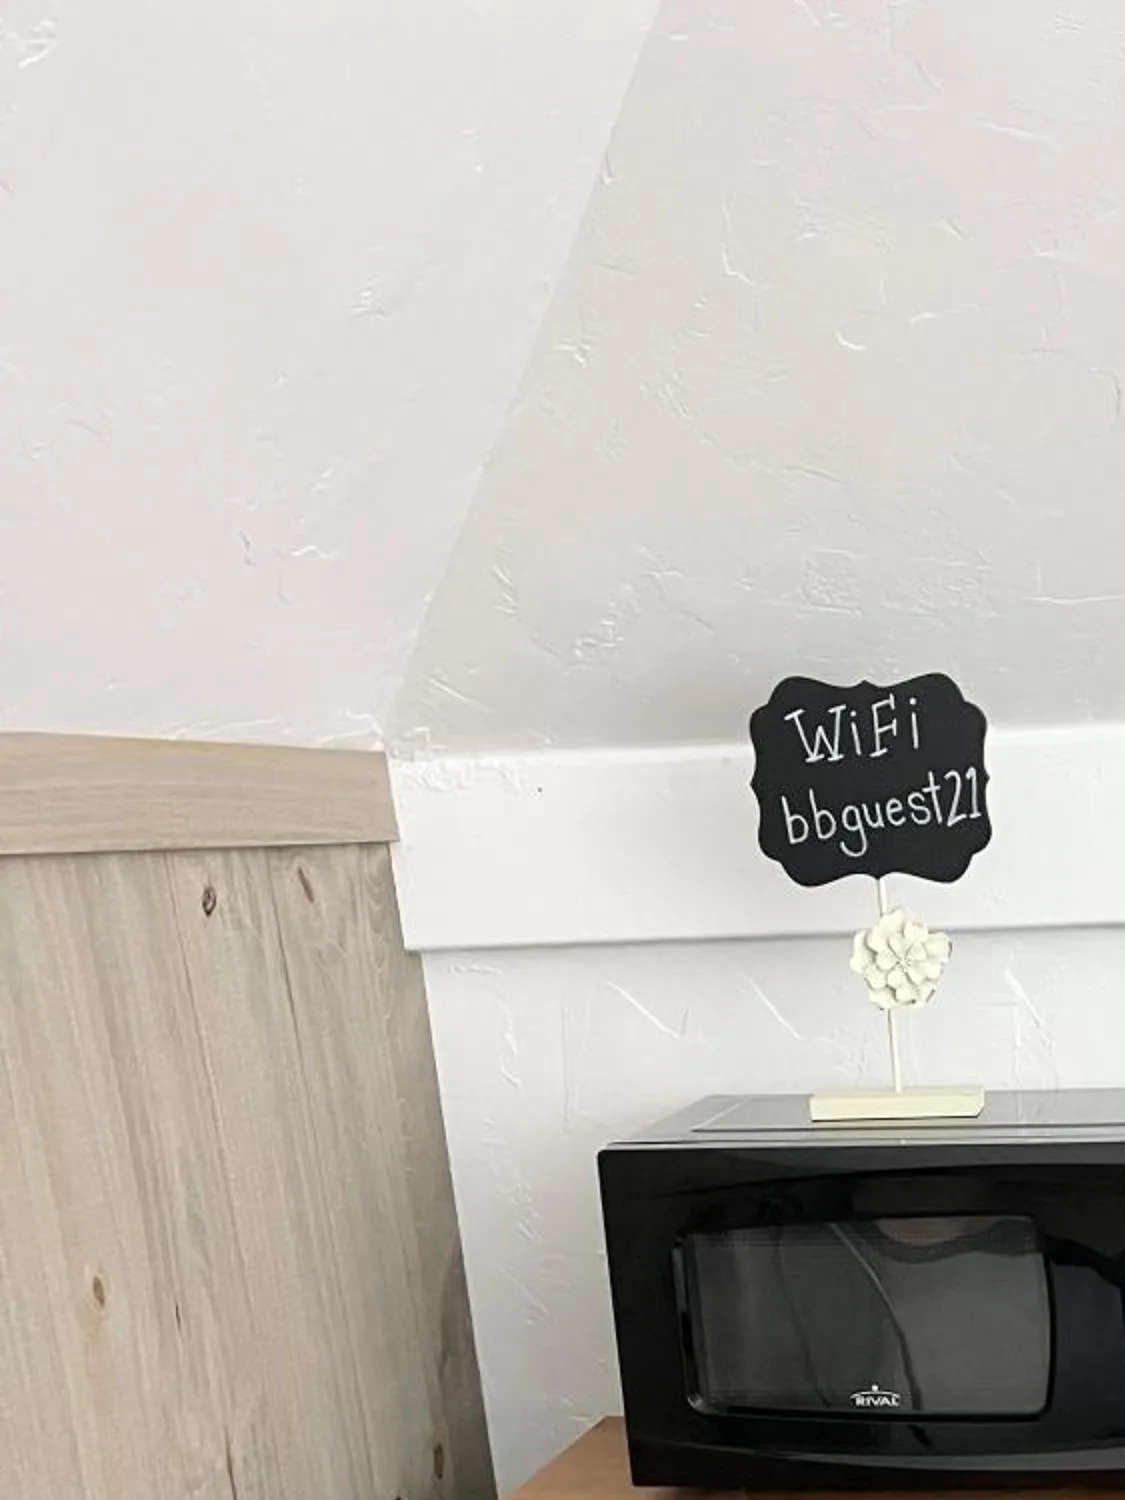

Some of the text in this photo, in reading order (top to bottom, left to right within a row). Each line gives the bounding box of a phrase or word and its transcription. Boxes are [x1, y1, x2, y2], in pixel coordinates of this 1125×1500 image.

[784, 693, 918, 763] WiFi
[781, 767, 981, 857] bbguest21
[855, 1395, 900, 1408] RIVAL
